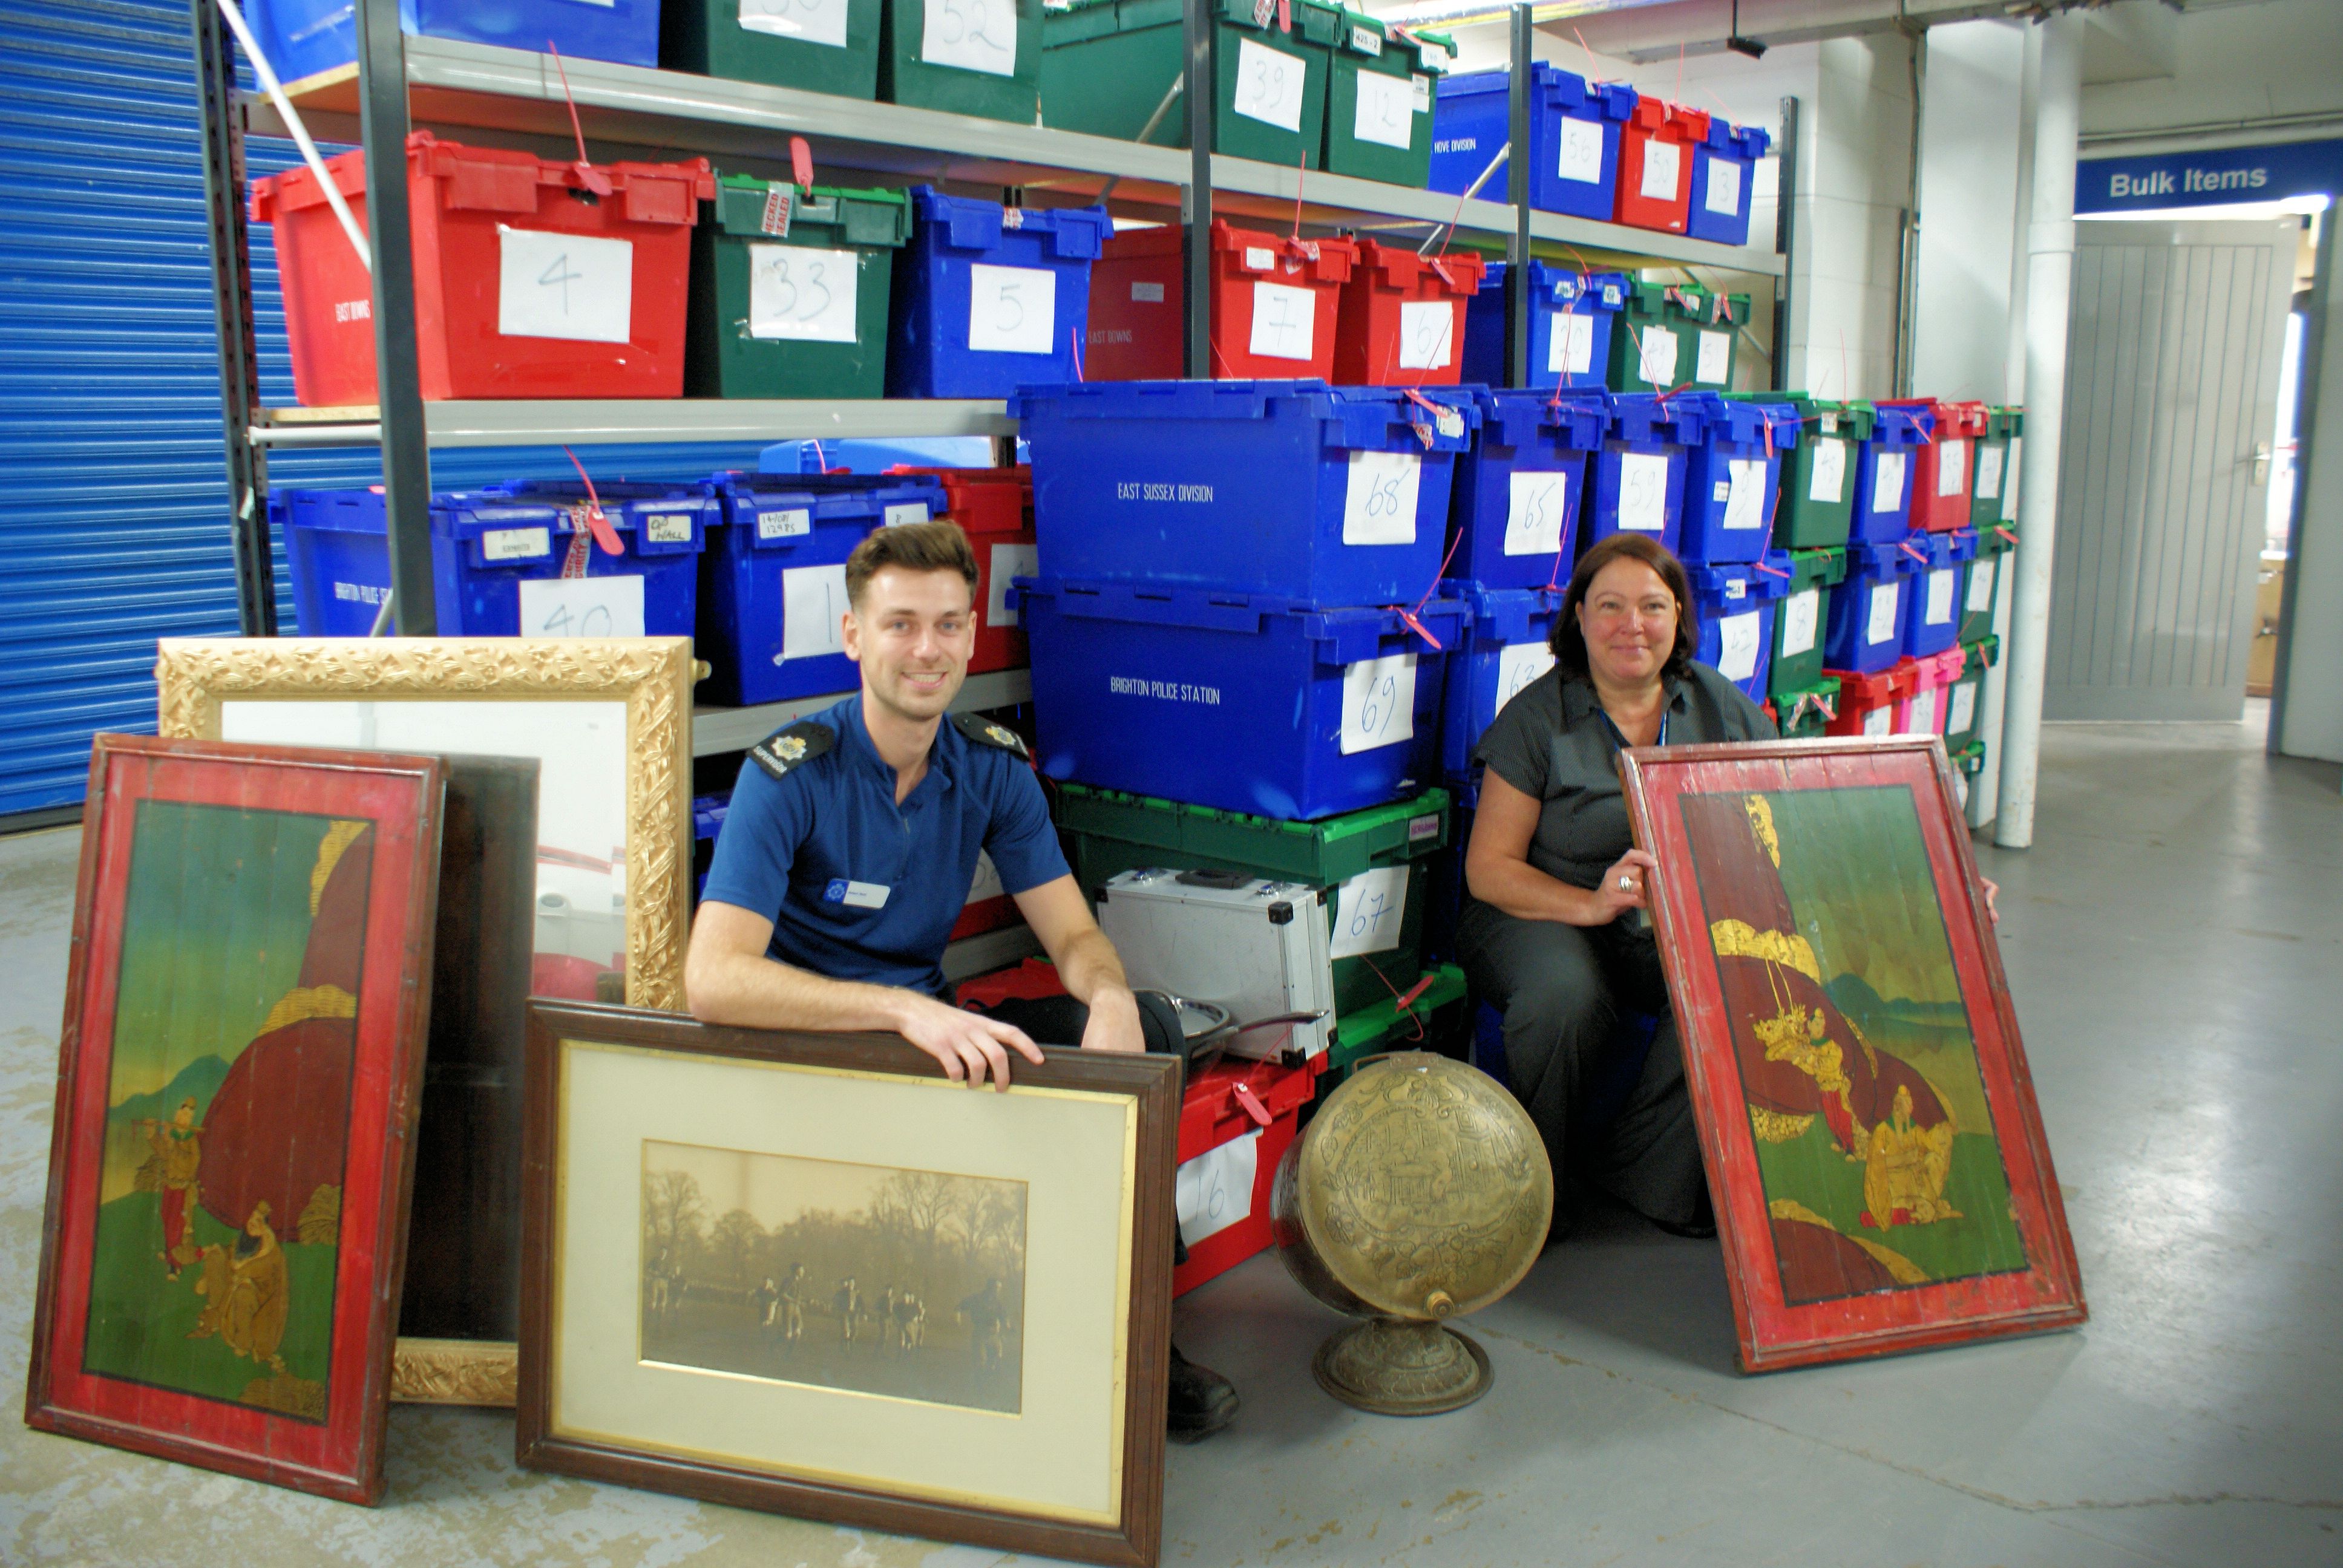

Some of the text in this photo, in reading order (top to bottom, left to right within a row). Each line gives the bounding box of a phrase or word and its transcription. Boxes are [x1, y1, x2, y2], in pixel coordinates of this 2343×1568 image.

[1254, 60, 1284, 108] 39
[1374, 89, 1397, 128] 12
[1434, 137, 1476, 154] HOVE DIVISION
[2109, 168, 2268, 197] Bulk Items
[539, 253, 582, 316] 4
[773, 258, 831, 322] 33
[996, 284, 1024, 332] 5
[1107, 329, 1133, 343] DOWNS
[1417, 309, 1432, 354] 6
[1118, 482, 1213, 503] EAST SUSSEX DIVISION
[1365, 467, 1411, 517] 68
[1523, 482, 1557, 531] 65
[544, 604, 612, 637] 40
[1110, 676, 1220, 705] BRIGHTON POLICE STATION
[1360, 675, 1395, 739] 69
[1351, 887, 1394, 936] 67
[1195, 1168, 1225, 1221] 16
